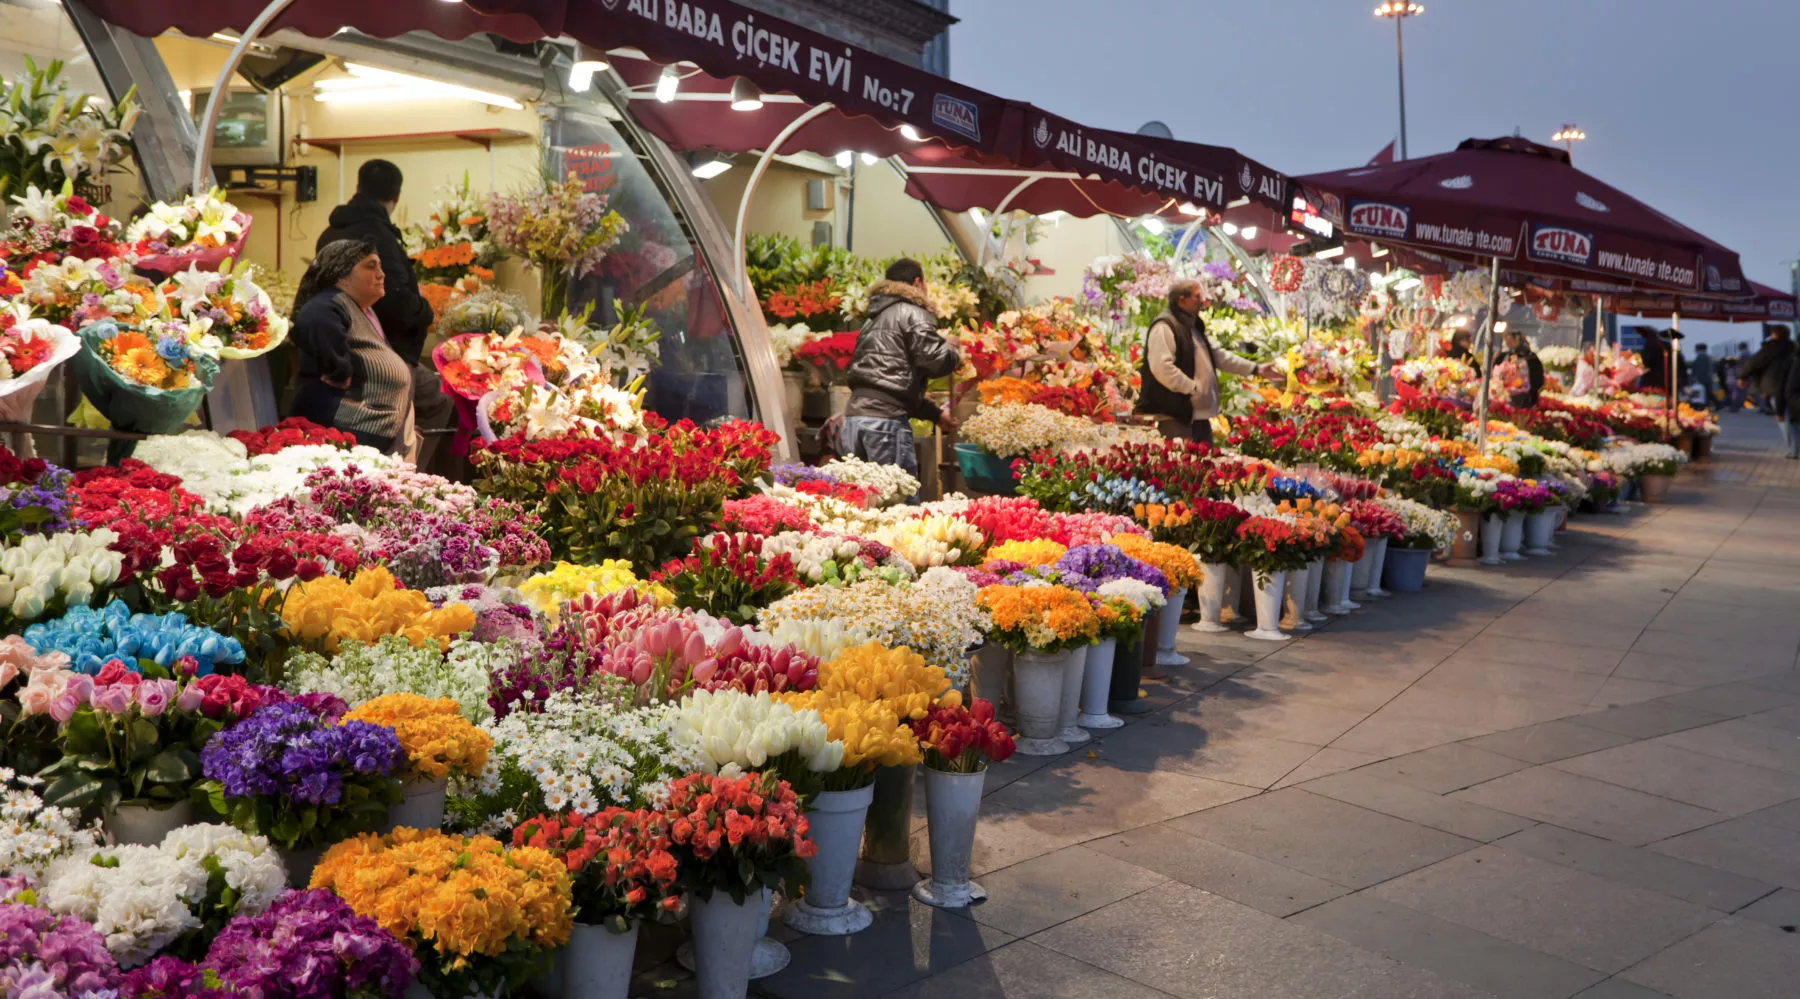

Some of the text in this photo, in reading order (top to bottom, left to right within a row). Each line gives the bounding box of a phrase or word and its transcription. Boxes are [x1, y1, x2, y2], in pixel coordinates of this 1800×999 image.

[664, 0, 724, 46] BABA
[731, 14, 801, 74] ÇİÇEK
[808, 47, 852, 93] EVİ
[862, 74, 915, 115] No:7
[1056, 129, 1224, 208] ALİ BABA ÇİÇEK EVİ
[1259, 173, 1281, 200] ALİ
[1353, 206, 1405, 229] TUNA
[1536, 231, 1587, 256] TUNA
